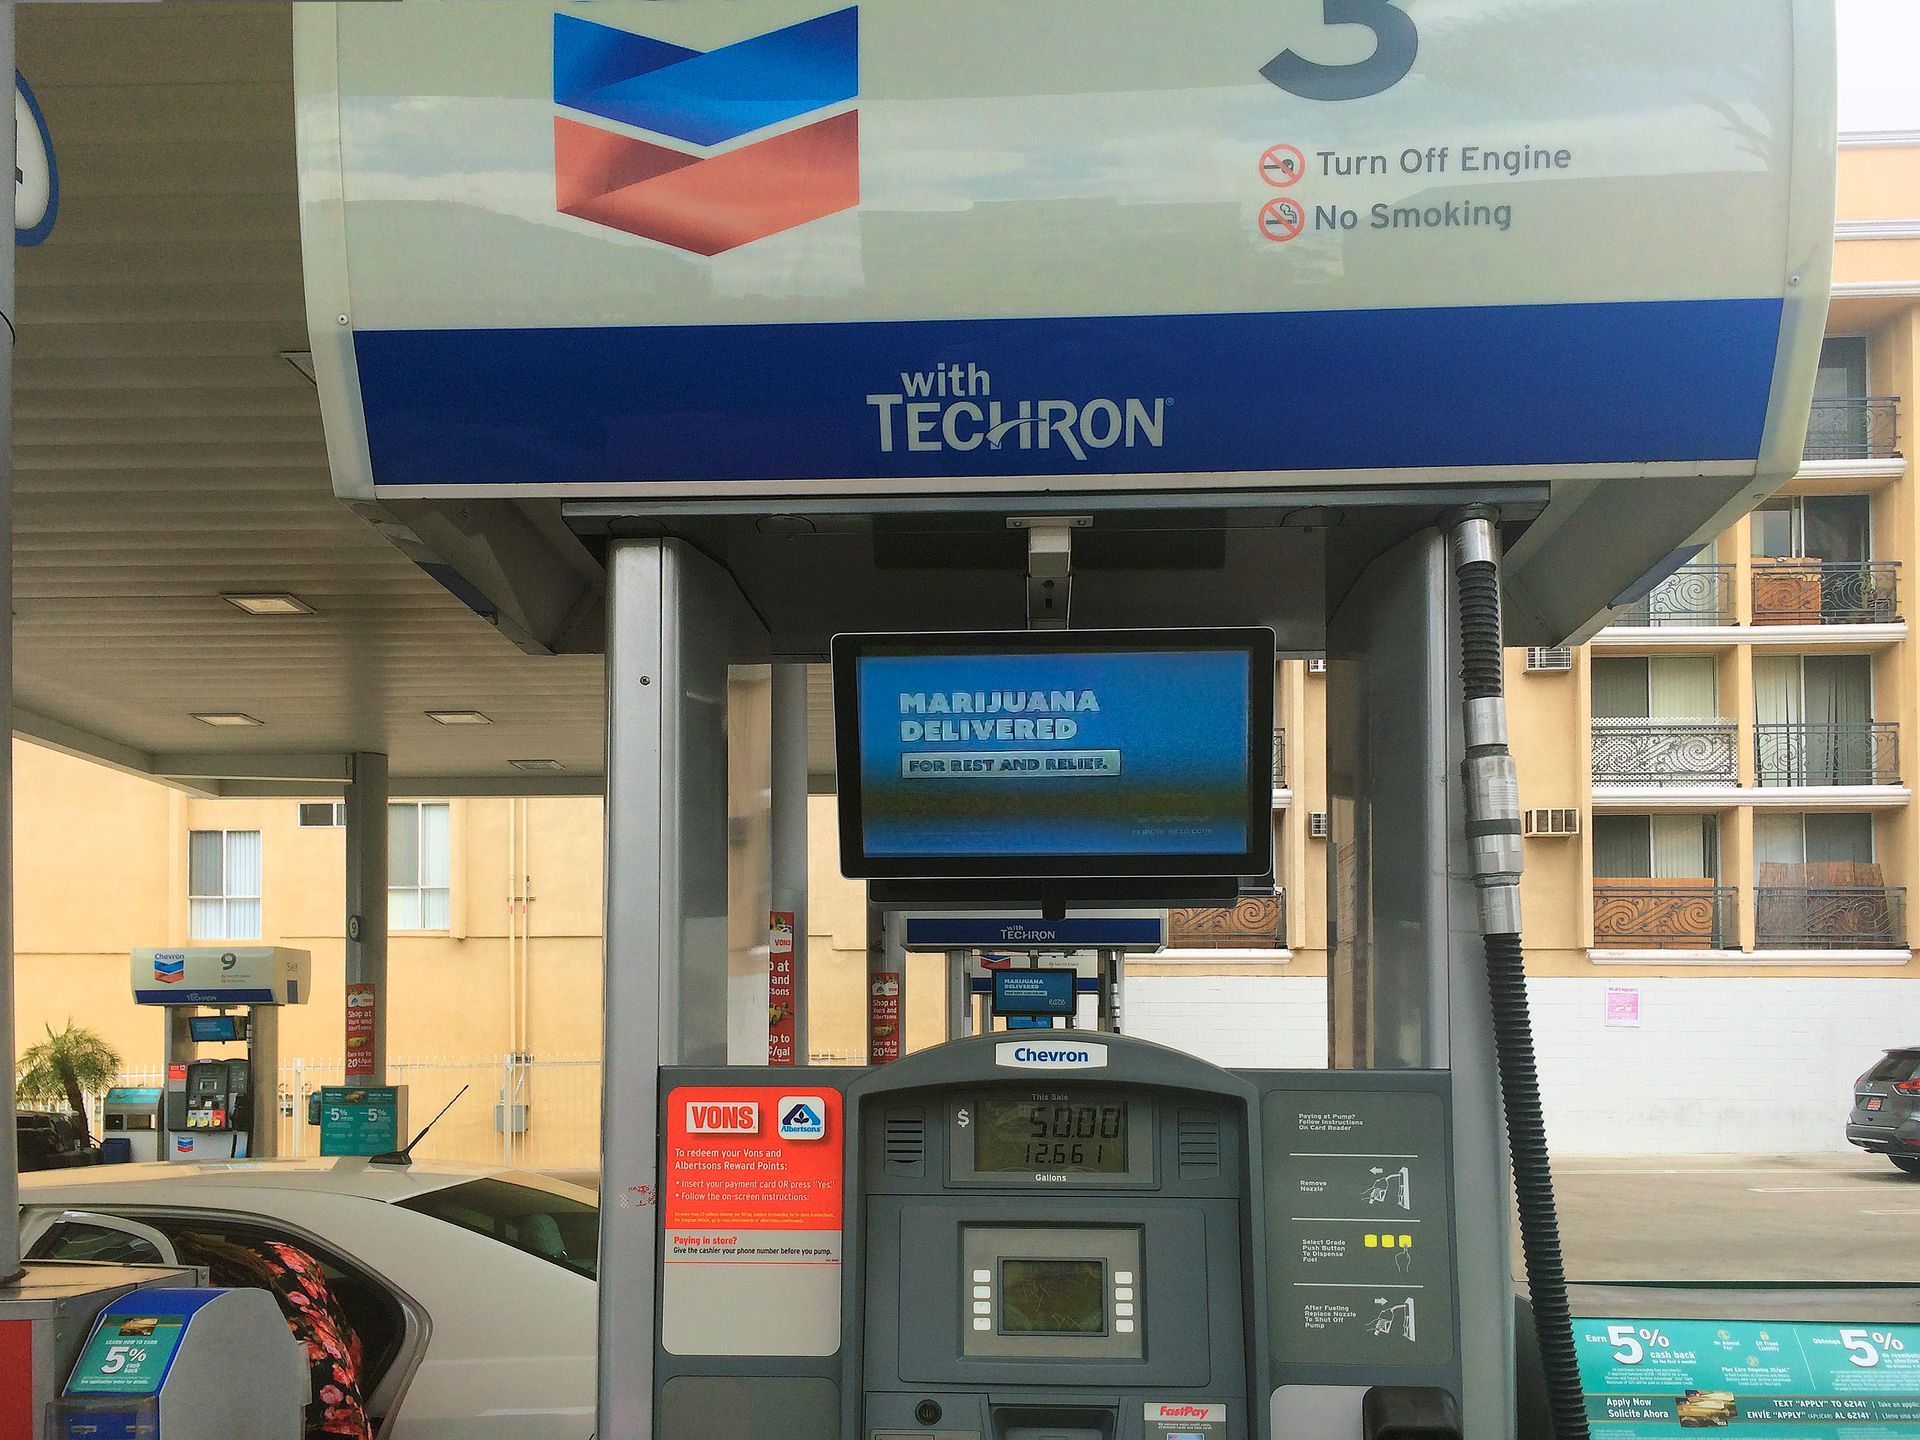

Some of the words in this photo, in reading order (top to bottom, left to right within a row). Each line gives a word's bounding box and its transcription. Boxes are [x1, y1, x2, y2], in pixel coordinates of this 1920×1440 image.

[1317, 151, 1387, 177] Turn
[1401, 147, 1449, 174] Off
[1463, 145, 1572, 177] Engine
[1315, 204, 1358, 230] No
[1370, 200, 1512, 231] Smoking
[901, 362, 990, 397] with
[866, 394, 1165, 460] TECHRON
[900, 690, 1101, 714] MARIJUANA
[901, 718, 1078, 742] DELIVERED
[909, 760, 946, 772] FOR
[950, 759, 994, 772] REST
[999, 758, 1040, 771] AND
[1045, 757, 1108, 771] RELIEF.
[1000, 929, 1057, 941] TECHRON
[154, 953, 185, 961] Chevron
[220, 952, 237, 971] 9
[771, 975, 790, 986] and
[1014, 1047, 1089, 1063] Chevron
[1031, 1093, 1049, 1101] This
[1051, 1093, 1069, 1101] Sale
[691, 1105, 754, 1129] VONS
[956, 1108, 971, 1128] $
[1029, 1106, 1121, 1139] 50.00
[780, 1125, 821, 1133] Albertsons
[674, 1148, 685, 1157] To
[686, 1148, 719, 1157] redeem
[721, 1149, 741, 1158] your
[743, 1149, 763, 1157] Vons
[765, 1149, 782, 1157] and
[1024, 1143, 1102, 1164] 12.661
[674, 1161, 722, 1170] Albertsons
[724, 1162, 755, 1170] Reward
[757, 1162, 788, 1170] Points:
[1035, 1173, 1067, 1182] Gallons
[681, 1179, 704, 1188] Insert
[706, 1181, 724, 1190] your
[724, 1180, 757, 1190] payment
[759, 1180, 777, 1188] card
[778, 1180, 789, 1188] OR
[790, 1182, 812, 1191] press
[681, 1192, 706, 1200] Follow
[707, 1192, 720, 1200] the
[721, 1192, 760, 1200] on-screen
[761, 1192, 810, 1201] instructions.
[673, 1236, 700, 1246] Paying
[702, 1236, 711, 1245] in
[712, 1236, 738, 1245] store?
[673, 1246, 687, 1254] Give
[687, 1246, 698, 1254] the
[737, 1247, 756, 1256] phone
[756, 1247, 780, 1255] number
[780, 1247, 801, 1255] before
[802, 1248, 813, 1256] you
[814, 1248, 833, 1256] pump.
[1585, 1334, 1607, 1342] Earn
[1606, 1325, 1670, 1365] 5%
[1839, 1329, 1904, 1368] 5%
[101, 1346, 146, 1373] 5%
[1650, 1351, 1672, 1359] cash
[1673, 1351, 1696, 1359] back
[1606, 1398, 1631, 1407] Apply
[1633, 1398, 1652, 1406] Now
[1796, 1400, 1829, 1408] "APPLY"
[1160, 1406, 1209, 1419] FastPay
[1608, 1410, 1641, 1418] Solicite
[1643, 1410, 1669, 1418] Ahora
[1747, 1410, 1771, 1419] ENVÍE
[1847, 1412, 1870, 1420] 62141
